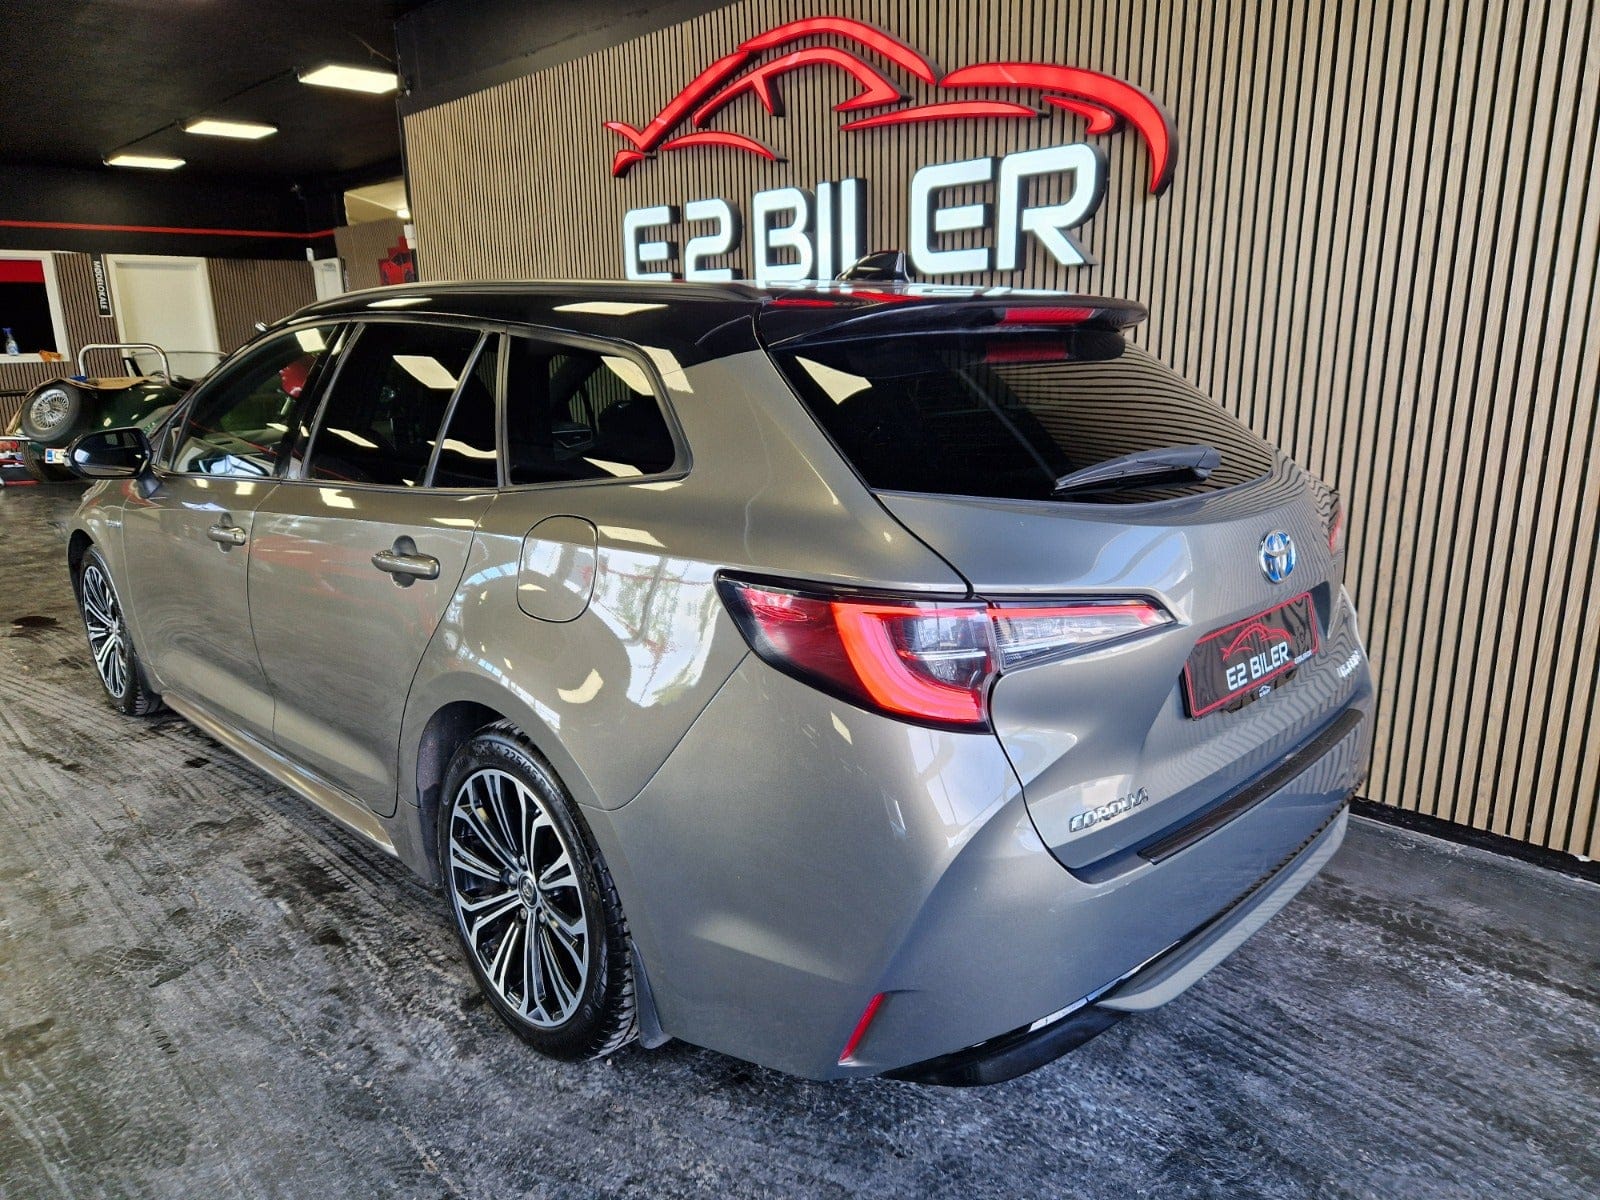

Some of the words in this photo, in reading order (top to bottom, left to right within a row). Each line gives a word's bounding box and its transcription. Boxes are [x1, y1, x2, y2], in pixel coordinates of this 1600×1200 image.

[624, 198, 738, 281] E2
[753, 142, 1102, 287] BILER
[1226, 662, 1248, 691] E2
[1249, 641, 1290, 680] BILER
[1069, 787, 1148, 832] COROLLA
